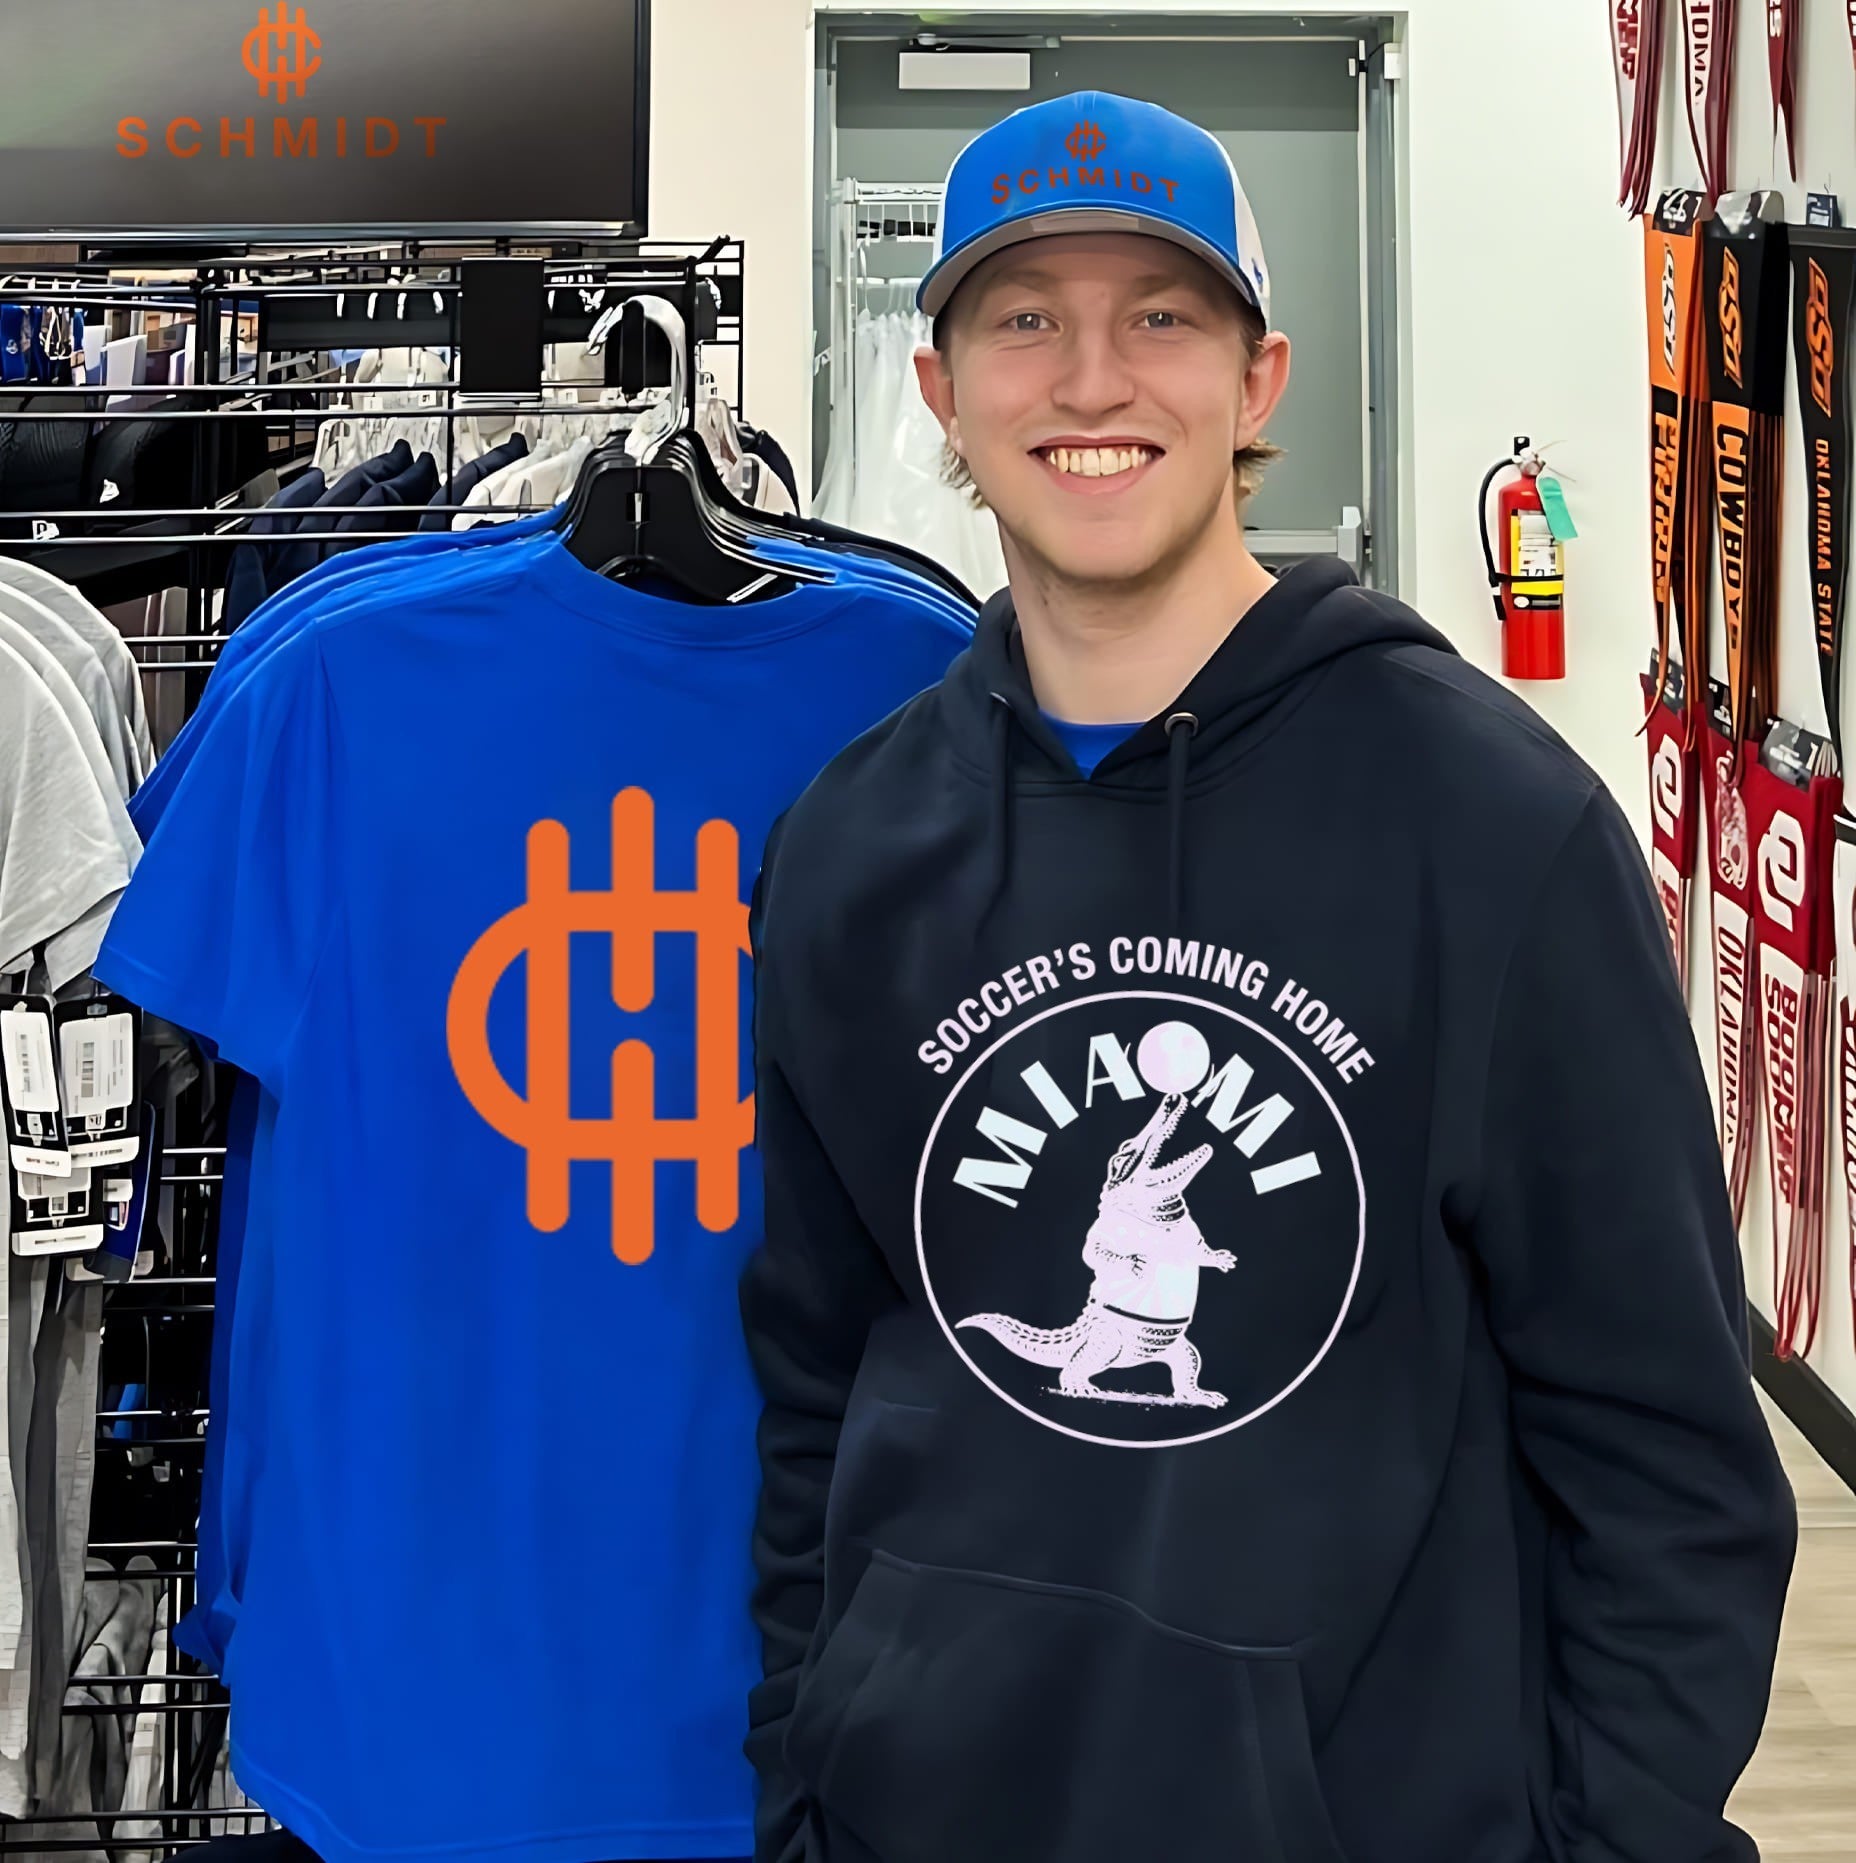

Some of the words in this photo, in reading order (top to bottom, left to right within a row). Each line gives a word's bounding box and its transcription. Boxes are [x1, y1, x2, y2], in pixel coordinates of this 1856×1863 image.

[116, 116, 447, 159] SCHMIDT
[992, 167, 1178, 204] SCHMIDT
[918, 943, 1096, 1074] SOCCER'S
[1110, 937, 1269, 1000] COMING
[1271, 979, 1375, 1084] HOME
[953, 1033, 1321, 1208] MIAMI
